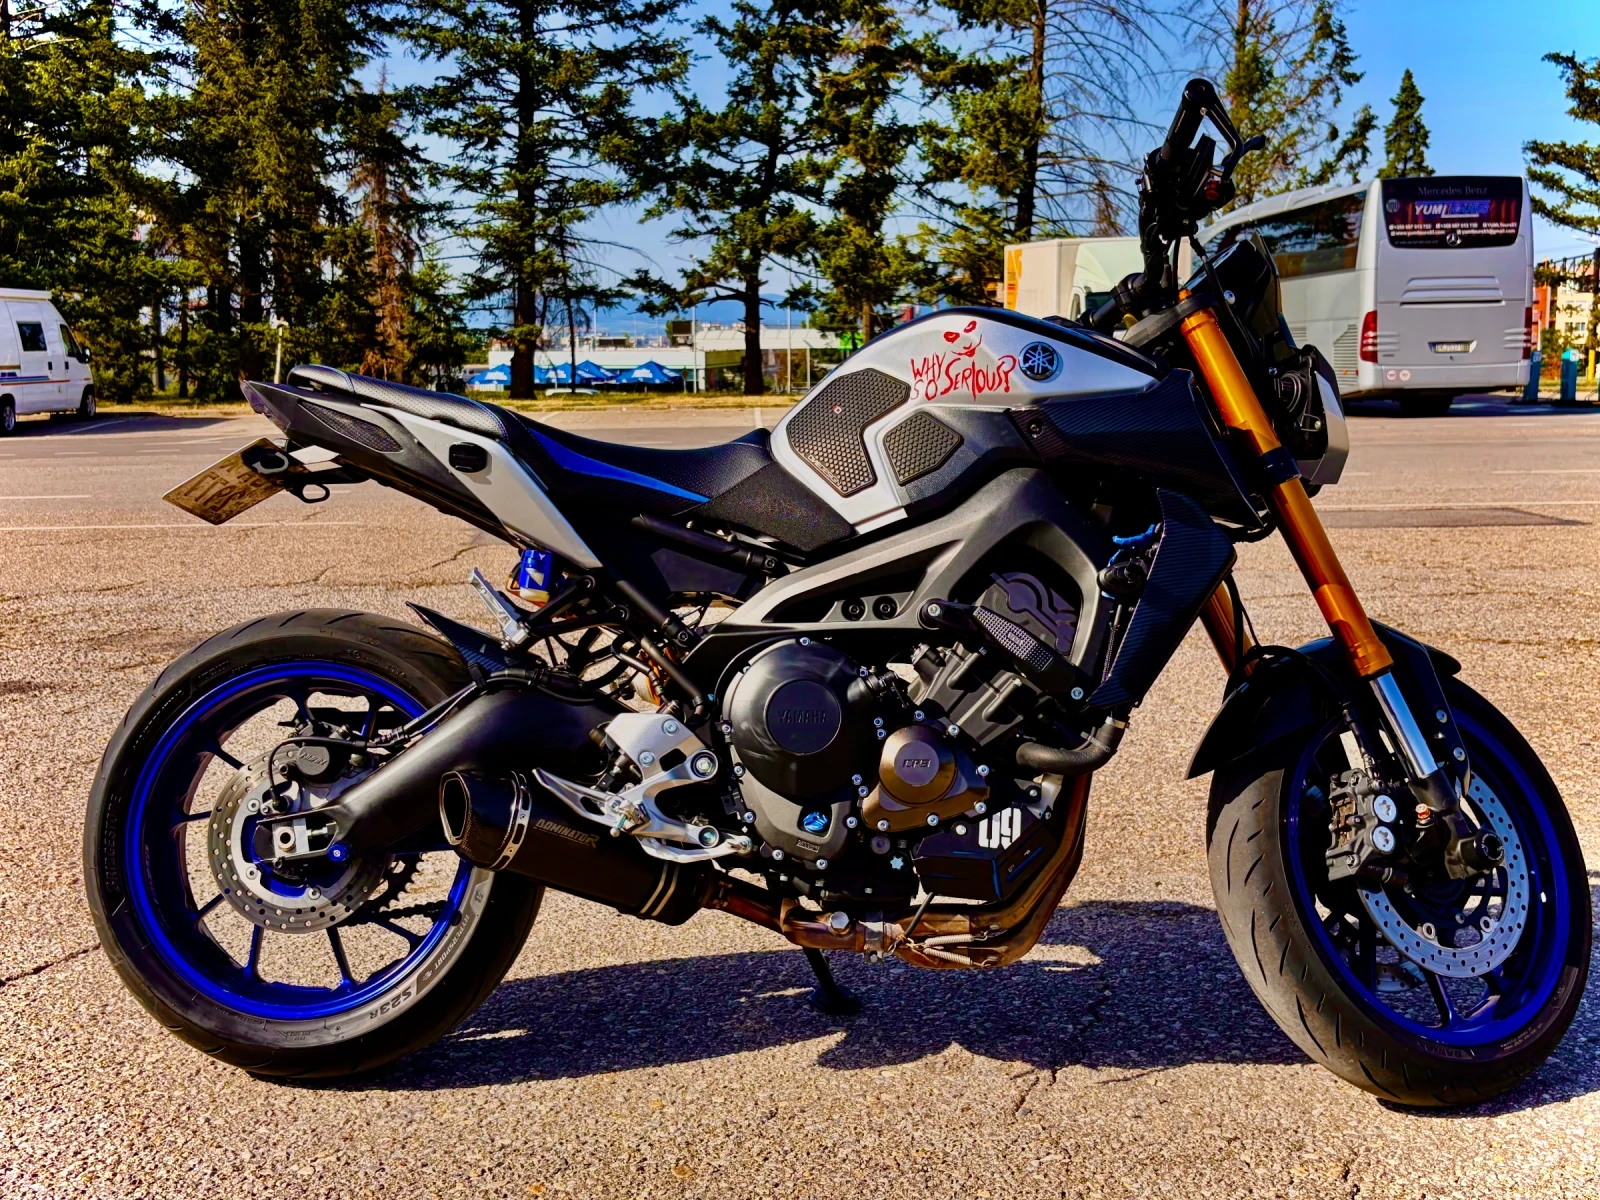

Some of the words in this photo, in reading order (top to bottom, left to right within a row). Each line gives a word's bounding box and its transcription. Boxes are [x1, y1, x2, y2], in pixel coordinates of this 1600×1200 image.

[1418, 186, 1462, 196] Mercedes
[1465, 186, 1488, 194] Benz
[910, 379, 938, 401] SO
[941, 355, 1017, 402] SERIOUS?
[911, 352, 946, 381] WHY
[779, 710, 827, 723] YAMAHA
[535, 818, 600, 848] DOMINATOR
